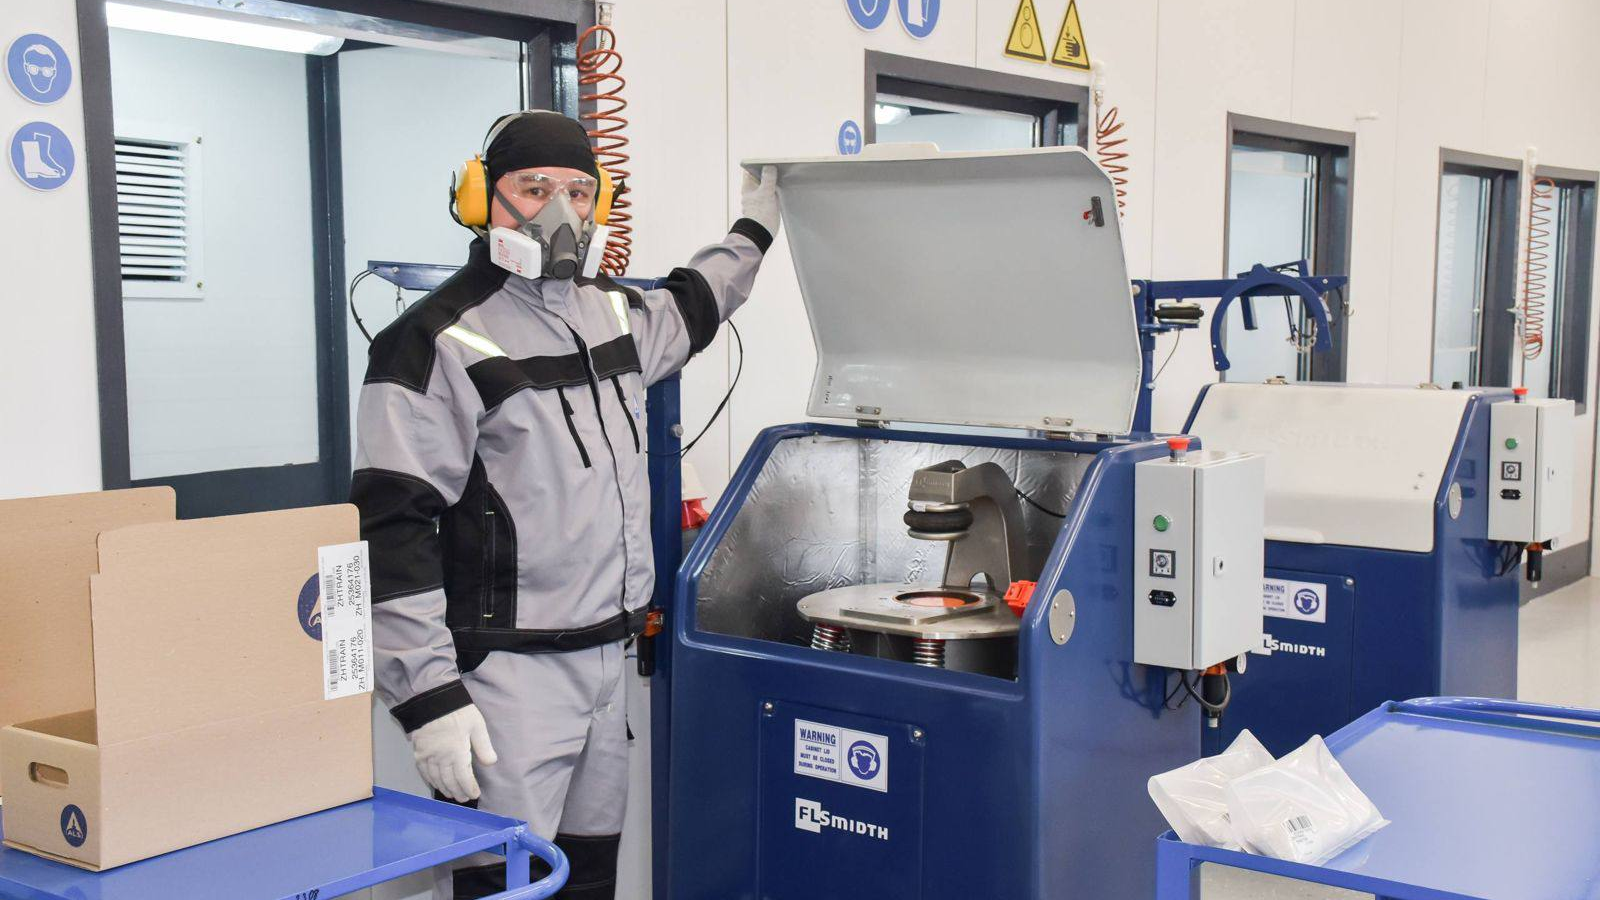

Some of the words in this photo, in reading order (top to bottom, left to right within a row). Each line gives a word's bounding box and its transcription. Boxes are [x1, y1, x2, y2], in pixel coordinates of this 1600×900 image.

[335, 565, 344, 607] ZHTRAIN
[347, 562, 355, 606] 25364176
[1263, 639, 1325, 657] LSMIDTH
[340, 639, 348, 681] ZHTRAIN
[799, 728, 836, 745] WARNING
[815, 764, 837, 774] OPERATION
[820, 756, 834, 764] CLOSED
